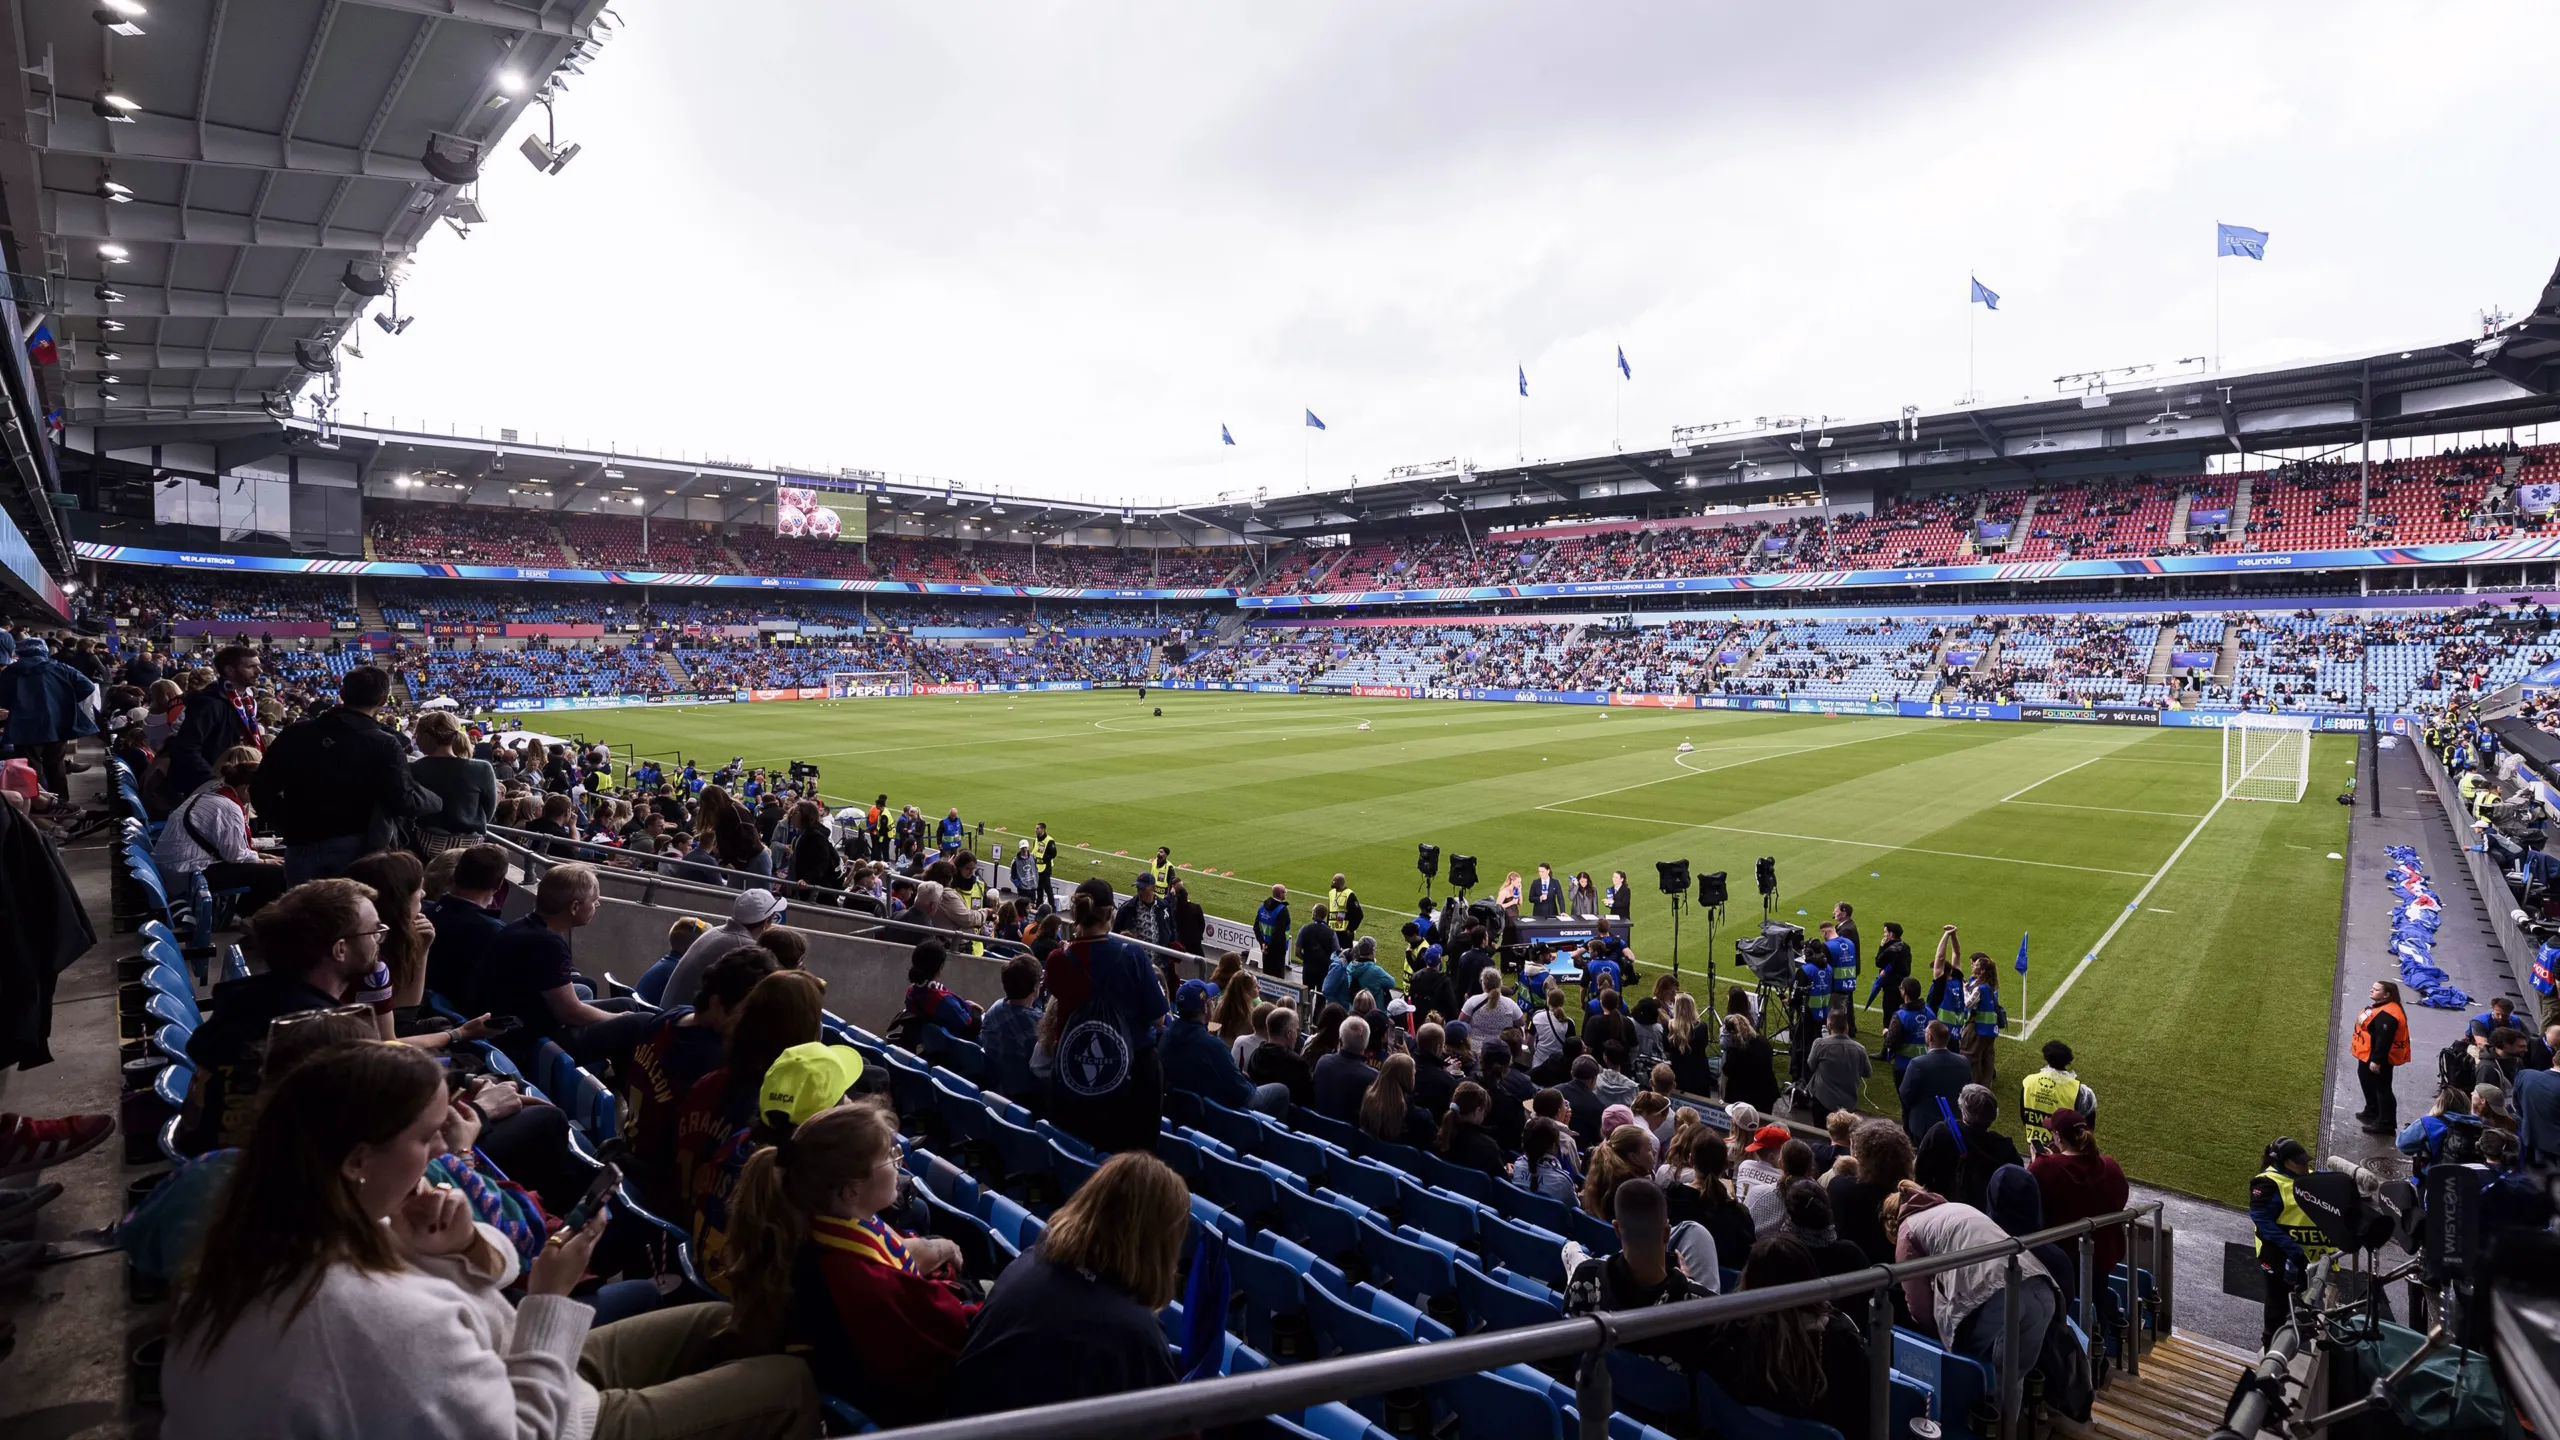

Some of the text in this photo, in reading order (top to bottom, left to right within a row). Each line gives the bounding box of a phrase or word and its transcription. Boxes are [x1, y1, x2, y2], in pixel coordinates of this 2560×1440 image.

[2244, 556, 2291, 566] euronics
[525, 570, 550, 579] RESPECT
[927, 685, 964, 693] vodafone
[1049, 681, 1082, 690] euronics
[1258, 684, 1290, 693] euronics
[847, 686, 885, 697] PEPSI
[1363, 688, 1398, 697] vodafone
[1425, 688, 1459, 699] PEPSI
[1616, 694, 1644, 702] amazon
[1658, 695, 1688, 703] amazon
[1701, 697, 1740, 708] WELCOME ALL
[502, 700, 542, 709] RECYCLE
[1752, 698, 1787, 710] #FOOTBALL
[1817, 700, 1835, 708] Every
[1948, 706, 1991, 717] PS5
[2023, 709, 2041, 717] UEFA
[2043, 710, 2095, 719] FOUNDATION
[1217, 927, 1256, 948] RESPECT
[1842, 968, 1856, 977] TV
[1074, 1054, 1114, 1065] SKECHERS
[769, 1092, 795, 1104] BARÇA
[2027, 1127, 2050, 1143] 786
[2294, 1186, 2342, 1217] WISYCOM
[2444, 1176, 2458, 1254] WISYCOM
